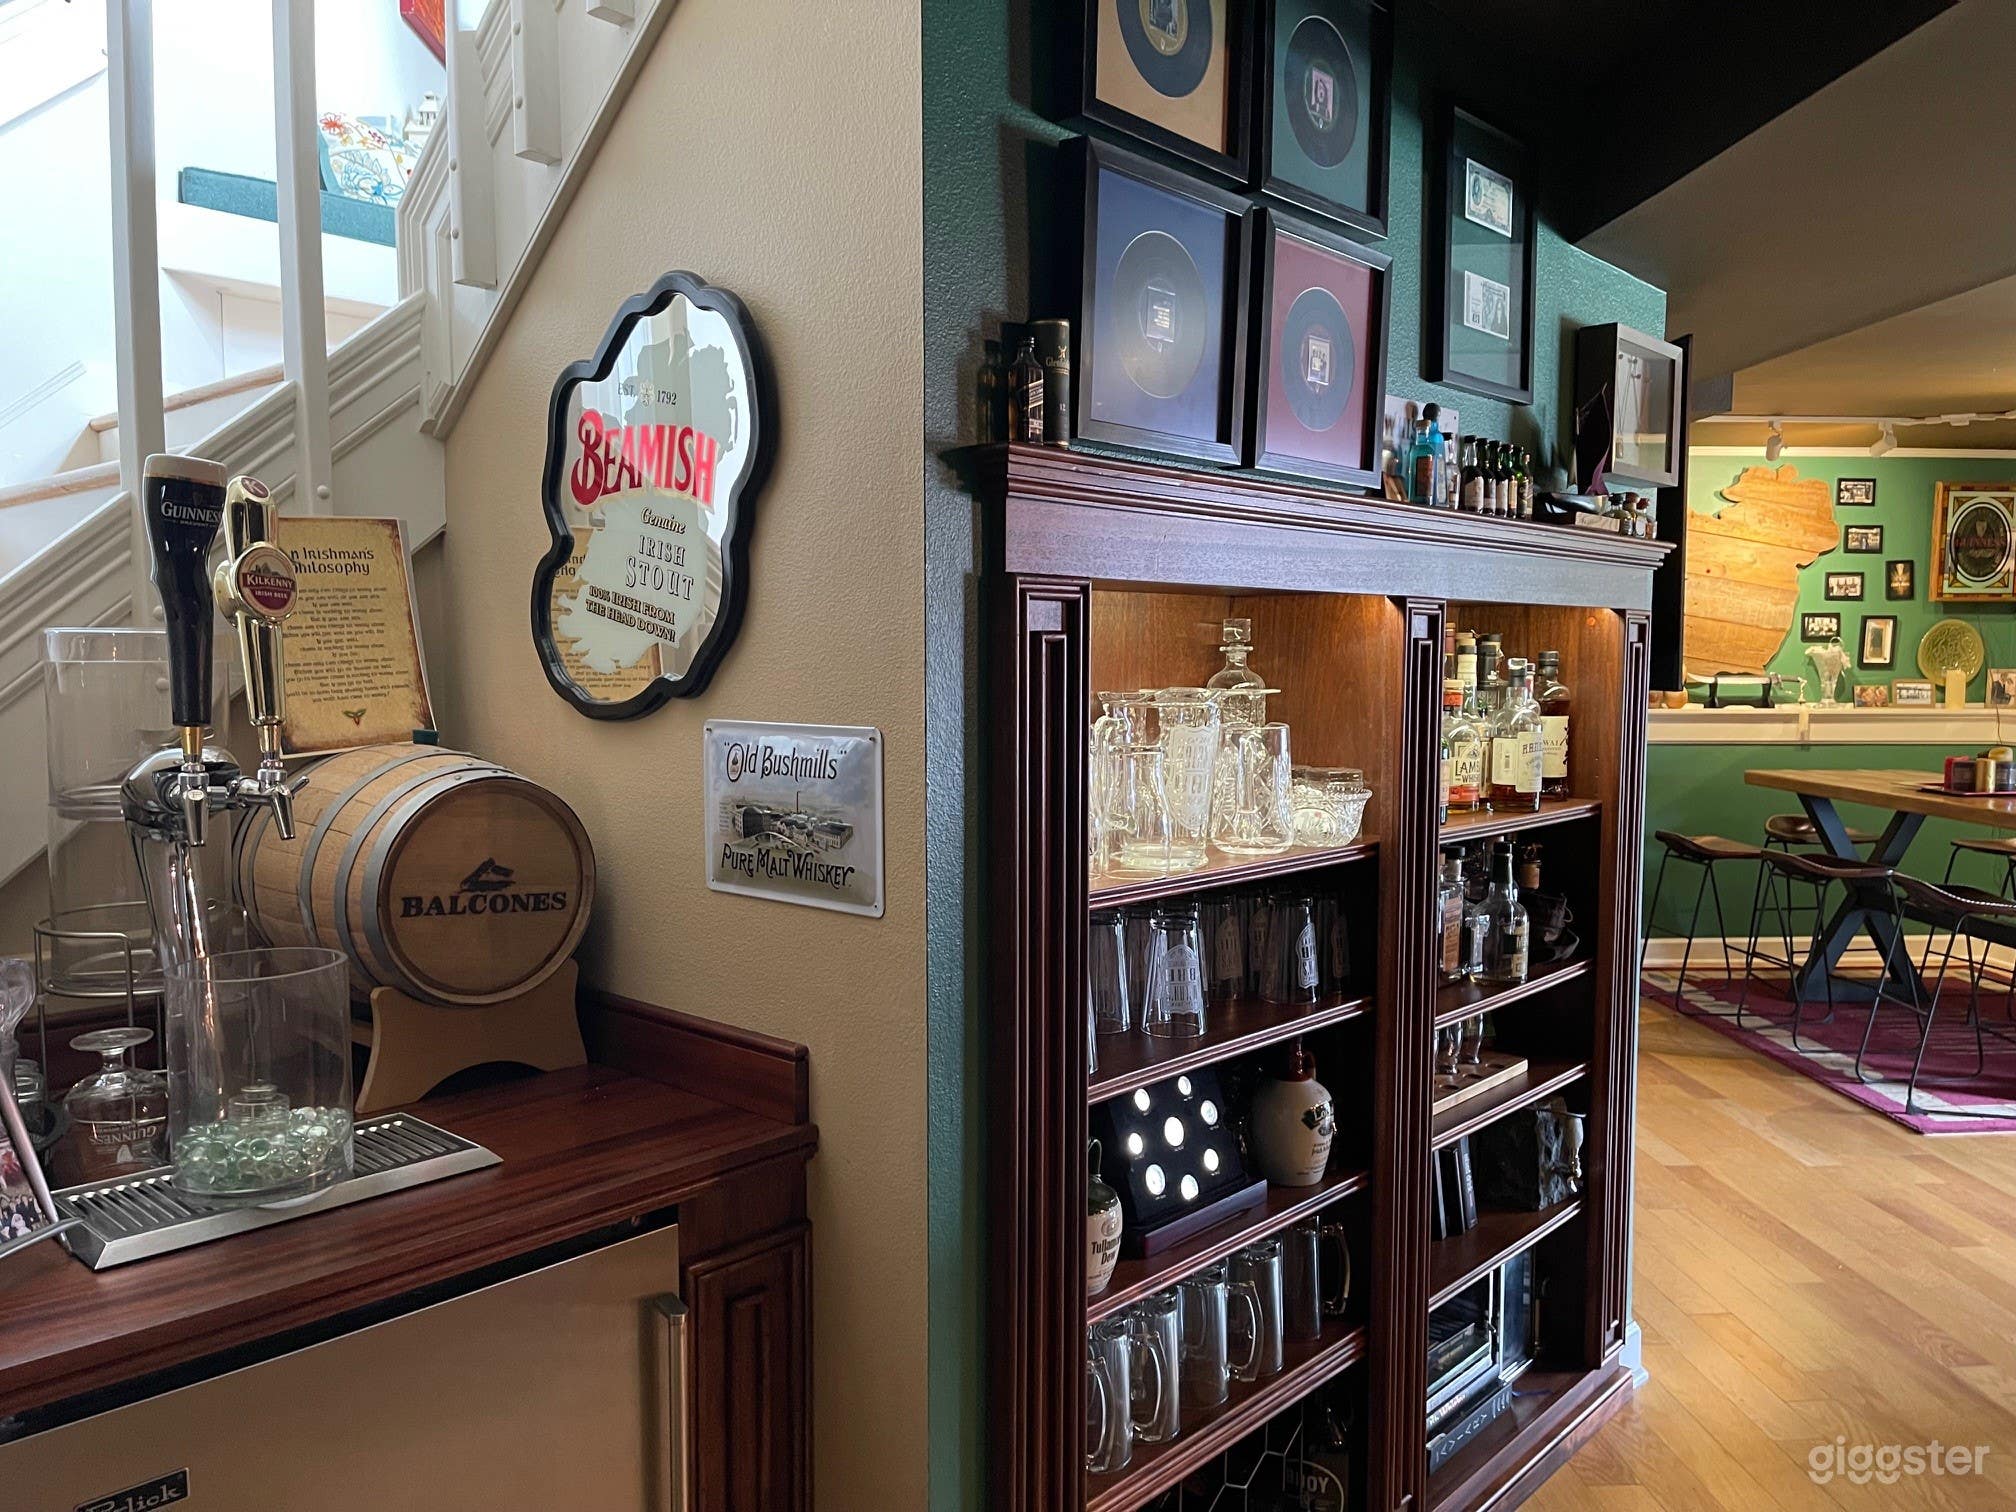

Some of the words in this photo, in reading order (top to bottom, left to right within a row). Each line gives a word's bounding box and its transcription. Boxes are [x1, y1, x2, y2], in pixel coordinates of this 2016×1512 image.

[657, 389, 678, 406] 1792
[570, 409, 718, 506] BEAMISH
[641, 506, 687, 535] Genuine
[638, 535, 686, 567] IRISH
[246, 573, 294, 589] KILKENNY
[625, 555, 694, 601] STOUT
[585, 598, 607, 618] THE
[606, 606, 637, 628] HEAD
[636, 617, 677, 643] DOWN!
[588, 585, 611, 603] 100%
[611, 591, 642, 614] IRISH
[641, 601, 676, 626] FROM
[400, 892, 567, 918] BALCONES
[87, 1125, 158, 1146] GUINNESS
